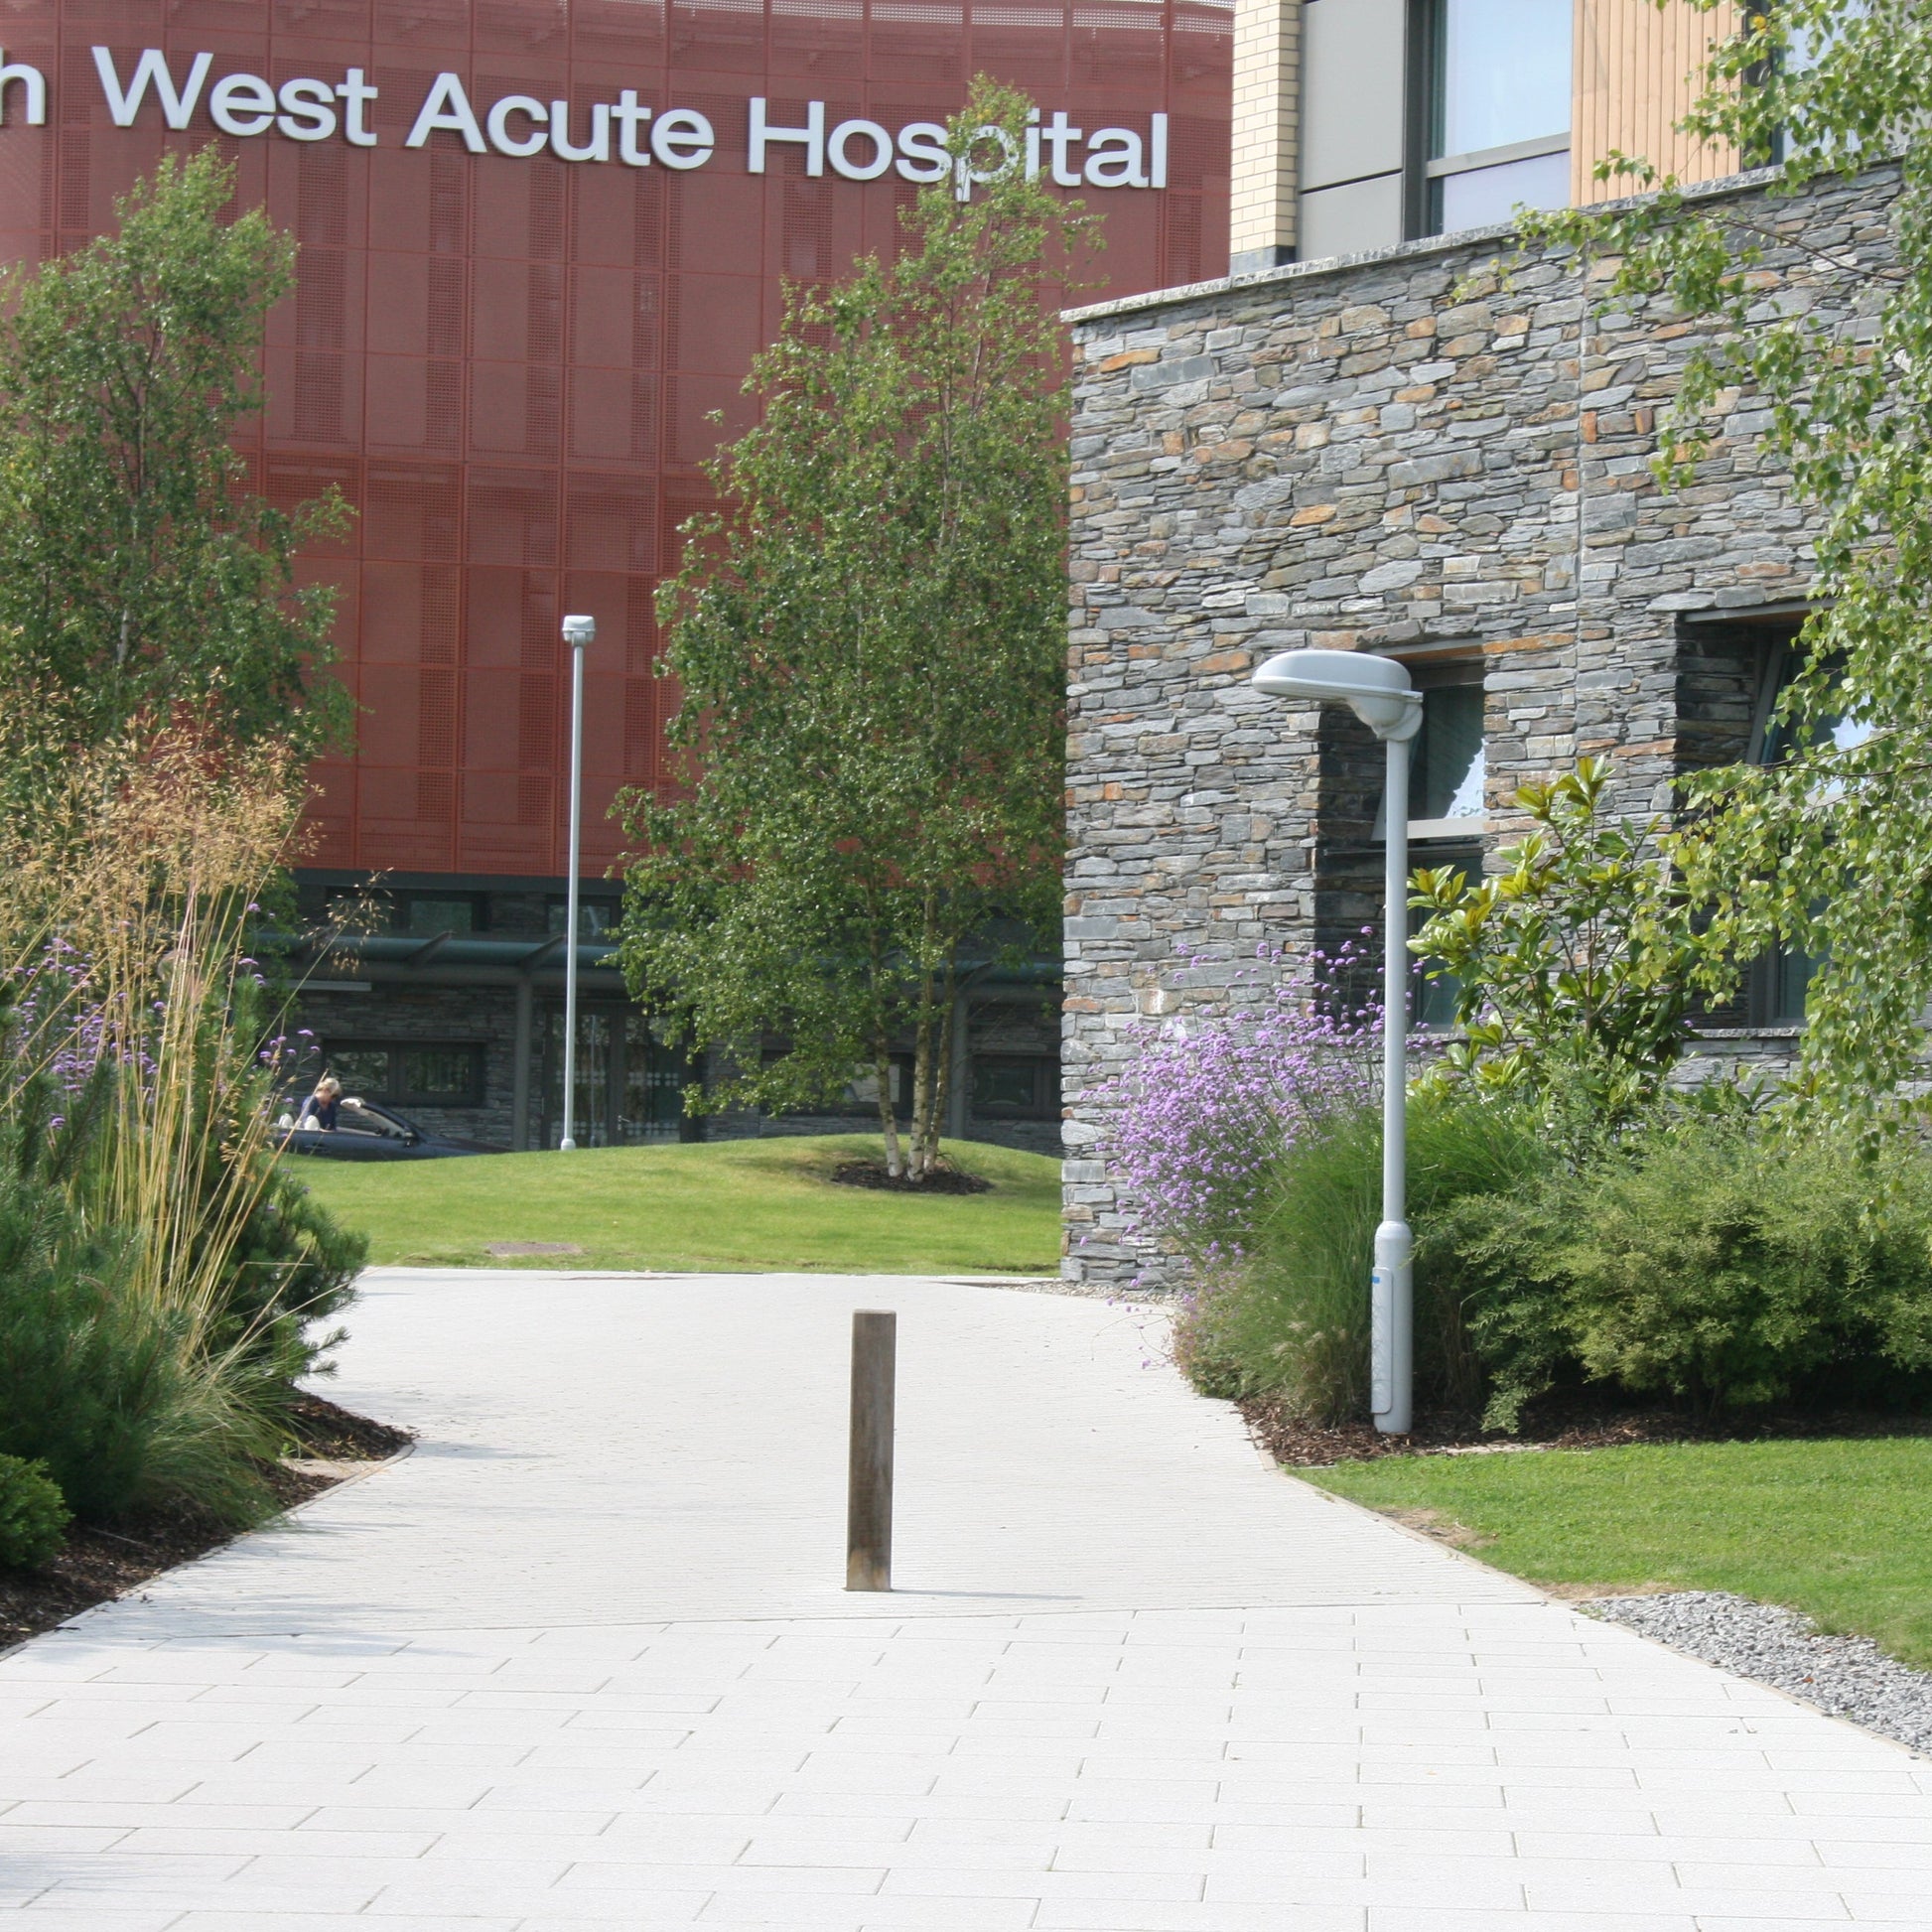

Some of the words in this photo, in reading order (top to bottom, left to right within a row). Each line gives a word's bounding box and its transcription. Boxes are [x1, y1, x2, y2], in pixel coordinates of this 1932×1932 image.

[91, 46, 378, 147] West
[405, 72, 715, 170] Acute
[748, 97, 1168, 202] Hospital
